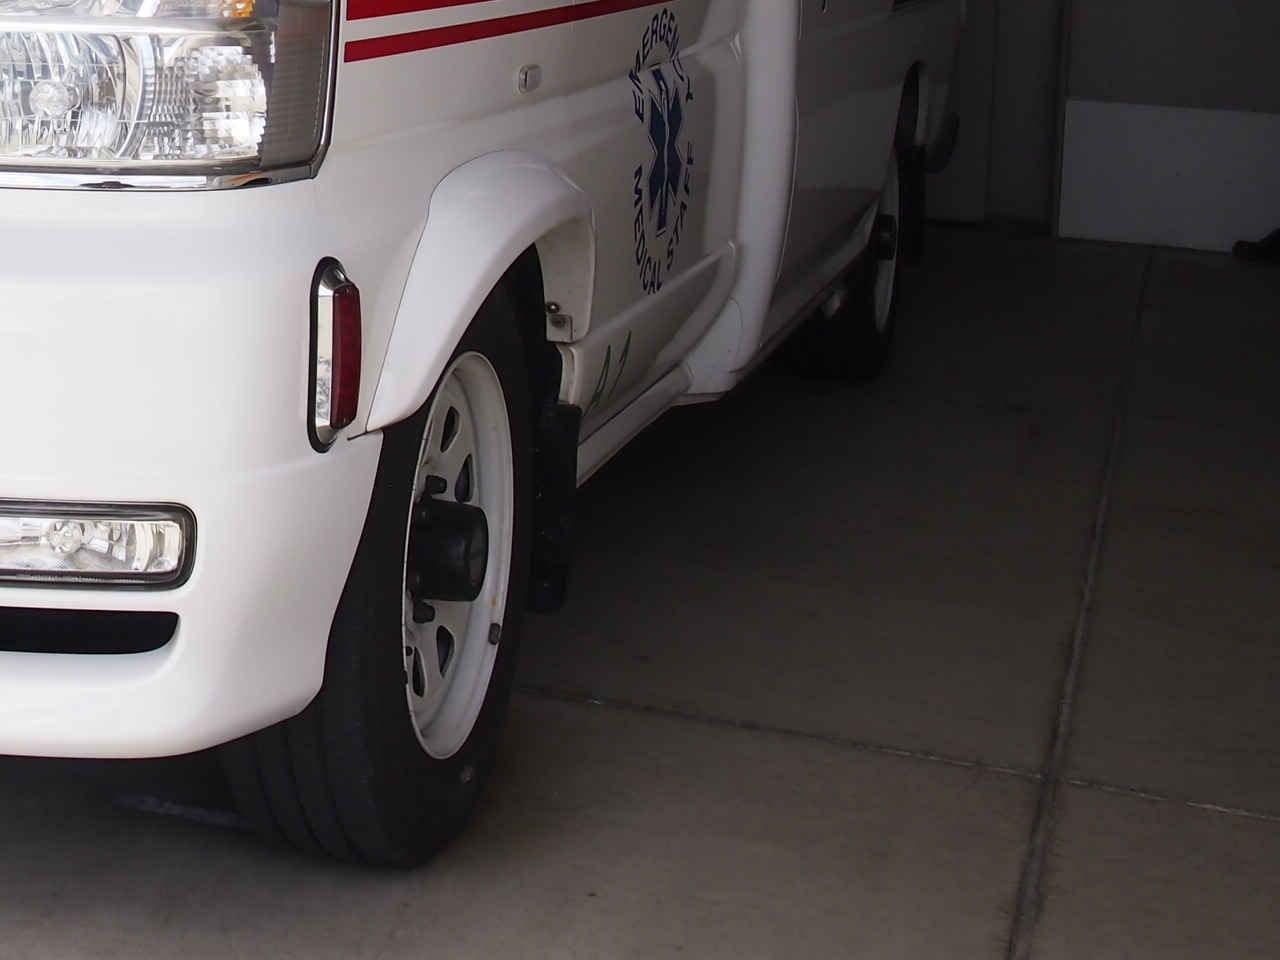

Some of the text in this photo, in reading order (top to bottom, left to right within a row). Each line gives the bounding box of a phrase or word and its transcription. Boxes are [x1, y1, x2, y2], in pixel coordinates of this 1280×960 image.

[628, 7, 694, 296] EMERGENCY MEDICAL STAFF
